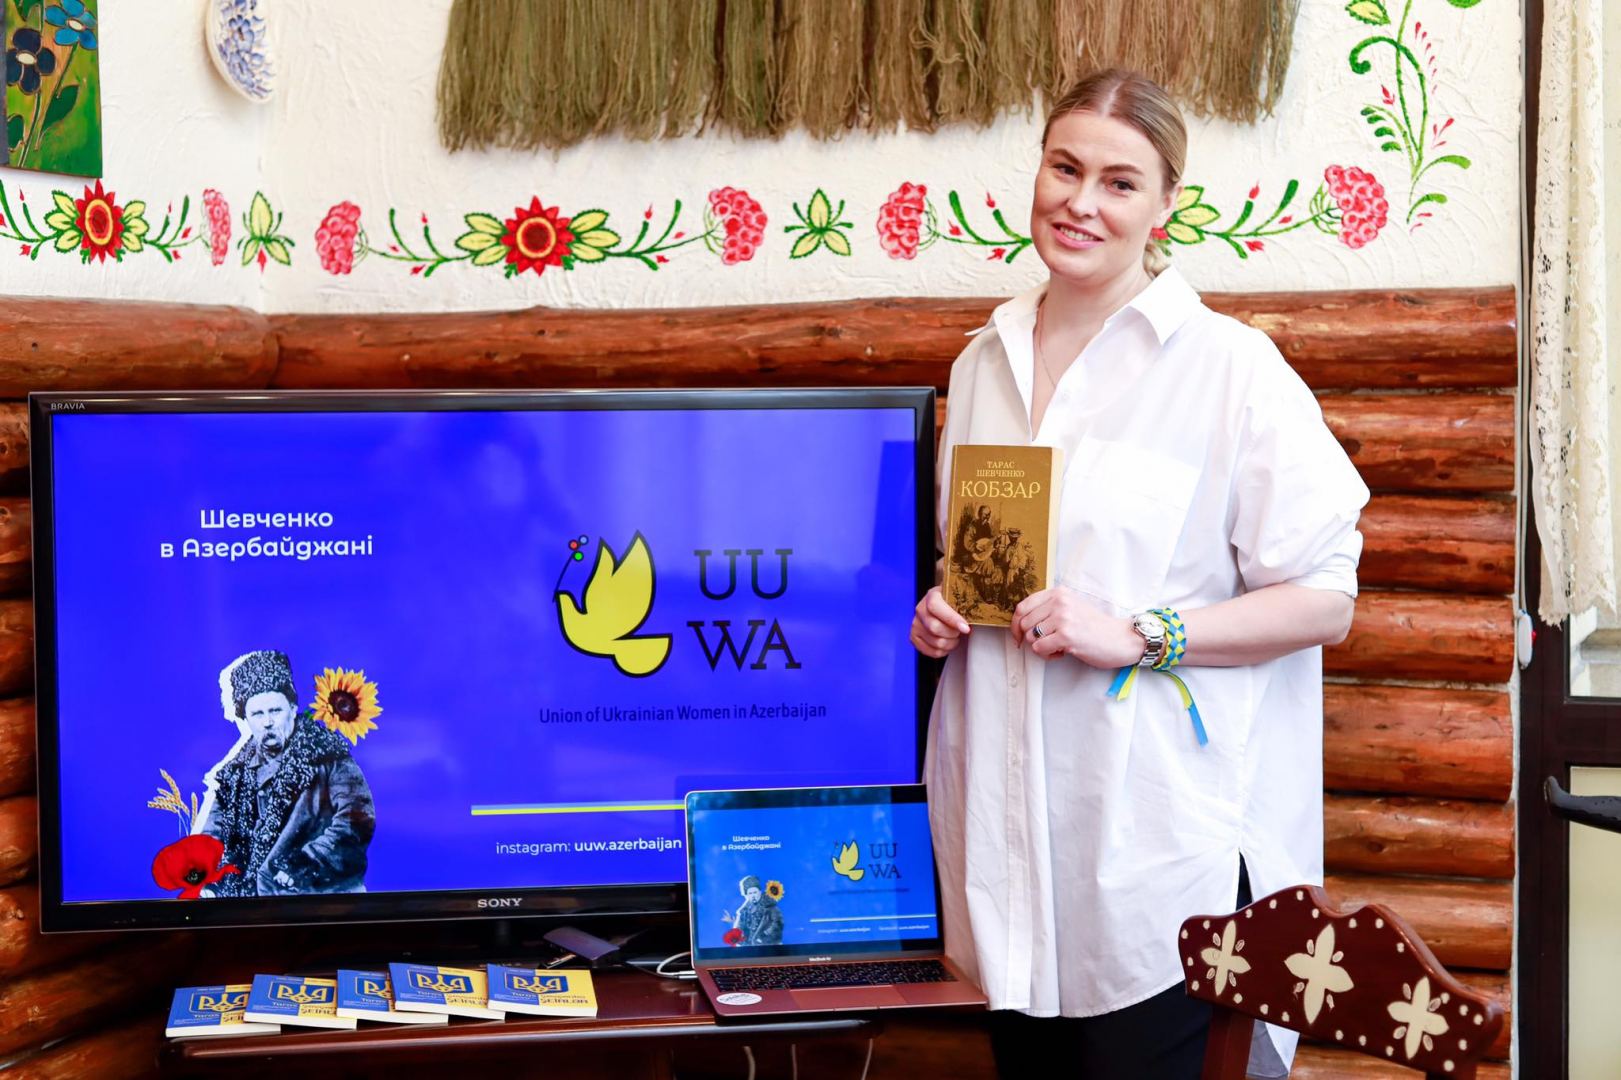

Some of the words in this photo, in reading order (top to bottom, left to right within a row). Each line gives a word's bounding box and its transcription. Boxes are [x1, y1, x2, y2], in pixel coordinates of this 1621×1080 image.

[51, 402, 85, 410] BRAVIA
[976, 469, 1025, 478] ШЕВЧЕНКО
[987, 461, 1015, 469] ТАРАС
[961, 480, 1040, 499] КОБЗАР
[200, 509, 334, 529] Шевченко
[160, 542, 175, 558] в
[182, 535, 373, 562] Азербайджані
[693, 548, 793, 601] UU
[686, 617, 802, 672] WA
[539, 707, 583, 724] Union
[586, 706, 600, 722] of
[603, 706, 674, 722] Ukrainian
[677, 704, 730, 720] Women
[734, 703, 747, 719] in
[750, 702, 827, 721] Azerbaijan
[496, 842, 571, 856] instagram:
[574, 837, 682, 852] uuw.azerbaijan
[869, 842, 898, 859] UU
[868, 863, 902, 879] WA
[477, 897, 522, 909] SONY
